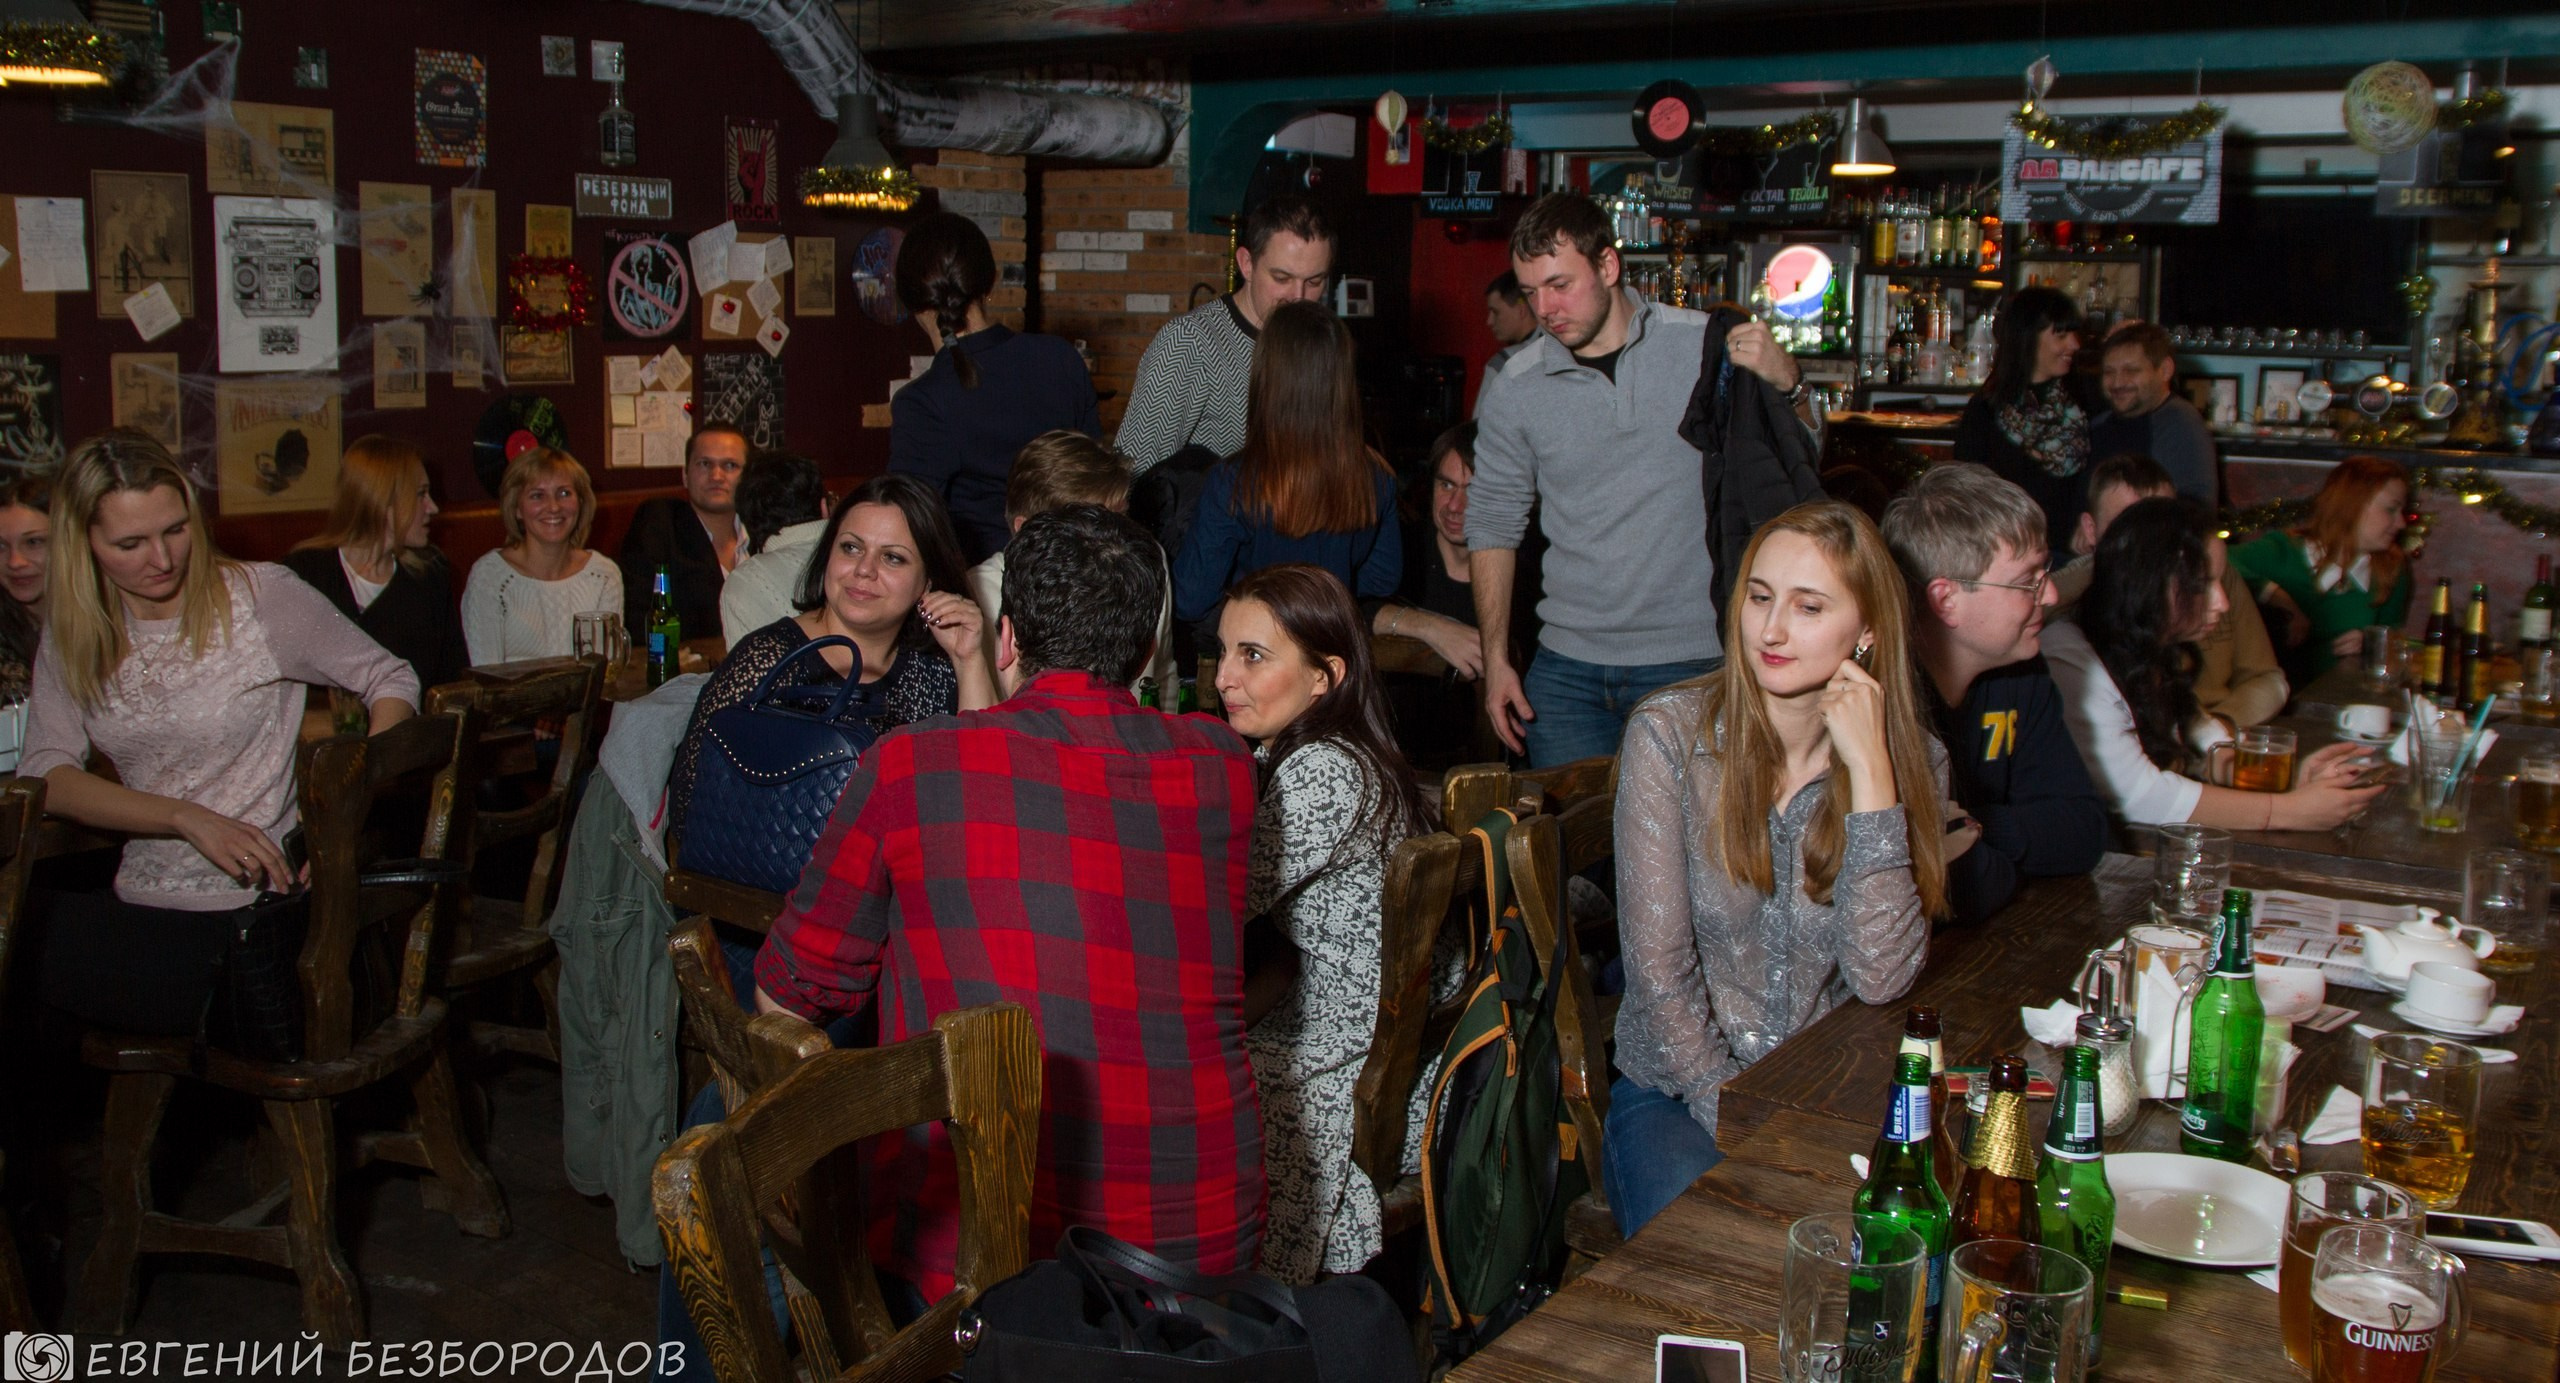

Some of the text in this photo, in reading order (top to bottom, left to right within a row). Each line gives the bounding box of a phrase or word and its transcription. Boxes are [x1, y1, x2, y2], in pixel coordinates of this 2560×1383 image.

[1652, 186, 1695, 200] WHISKEY
[1789, 186, 1829, 201] TEQUILA
[610, 197, 650, 216] ФОНД
[1429, 196, 1494, 210] VODKA MENU
[1651, 201, 1693, 211] OLD BRAND
[1750, 204, 1766, 213] MIX
[732, 204, 774, 219] ROCK
[2345, 1321, 2438, 1353] GUINNESS
